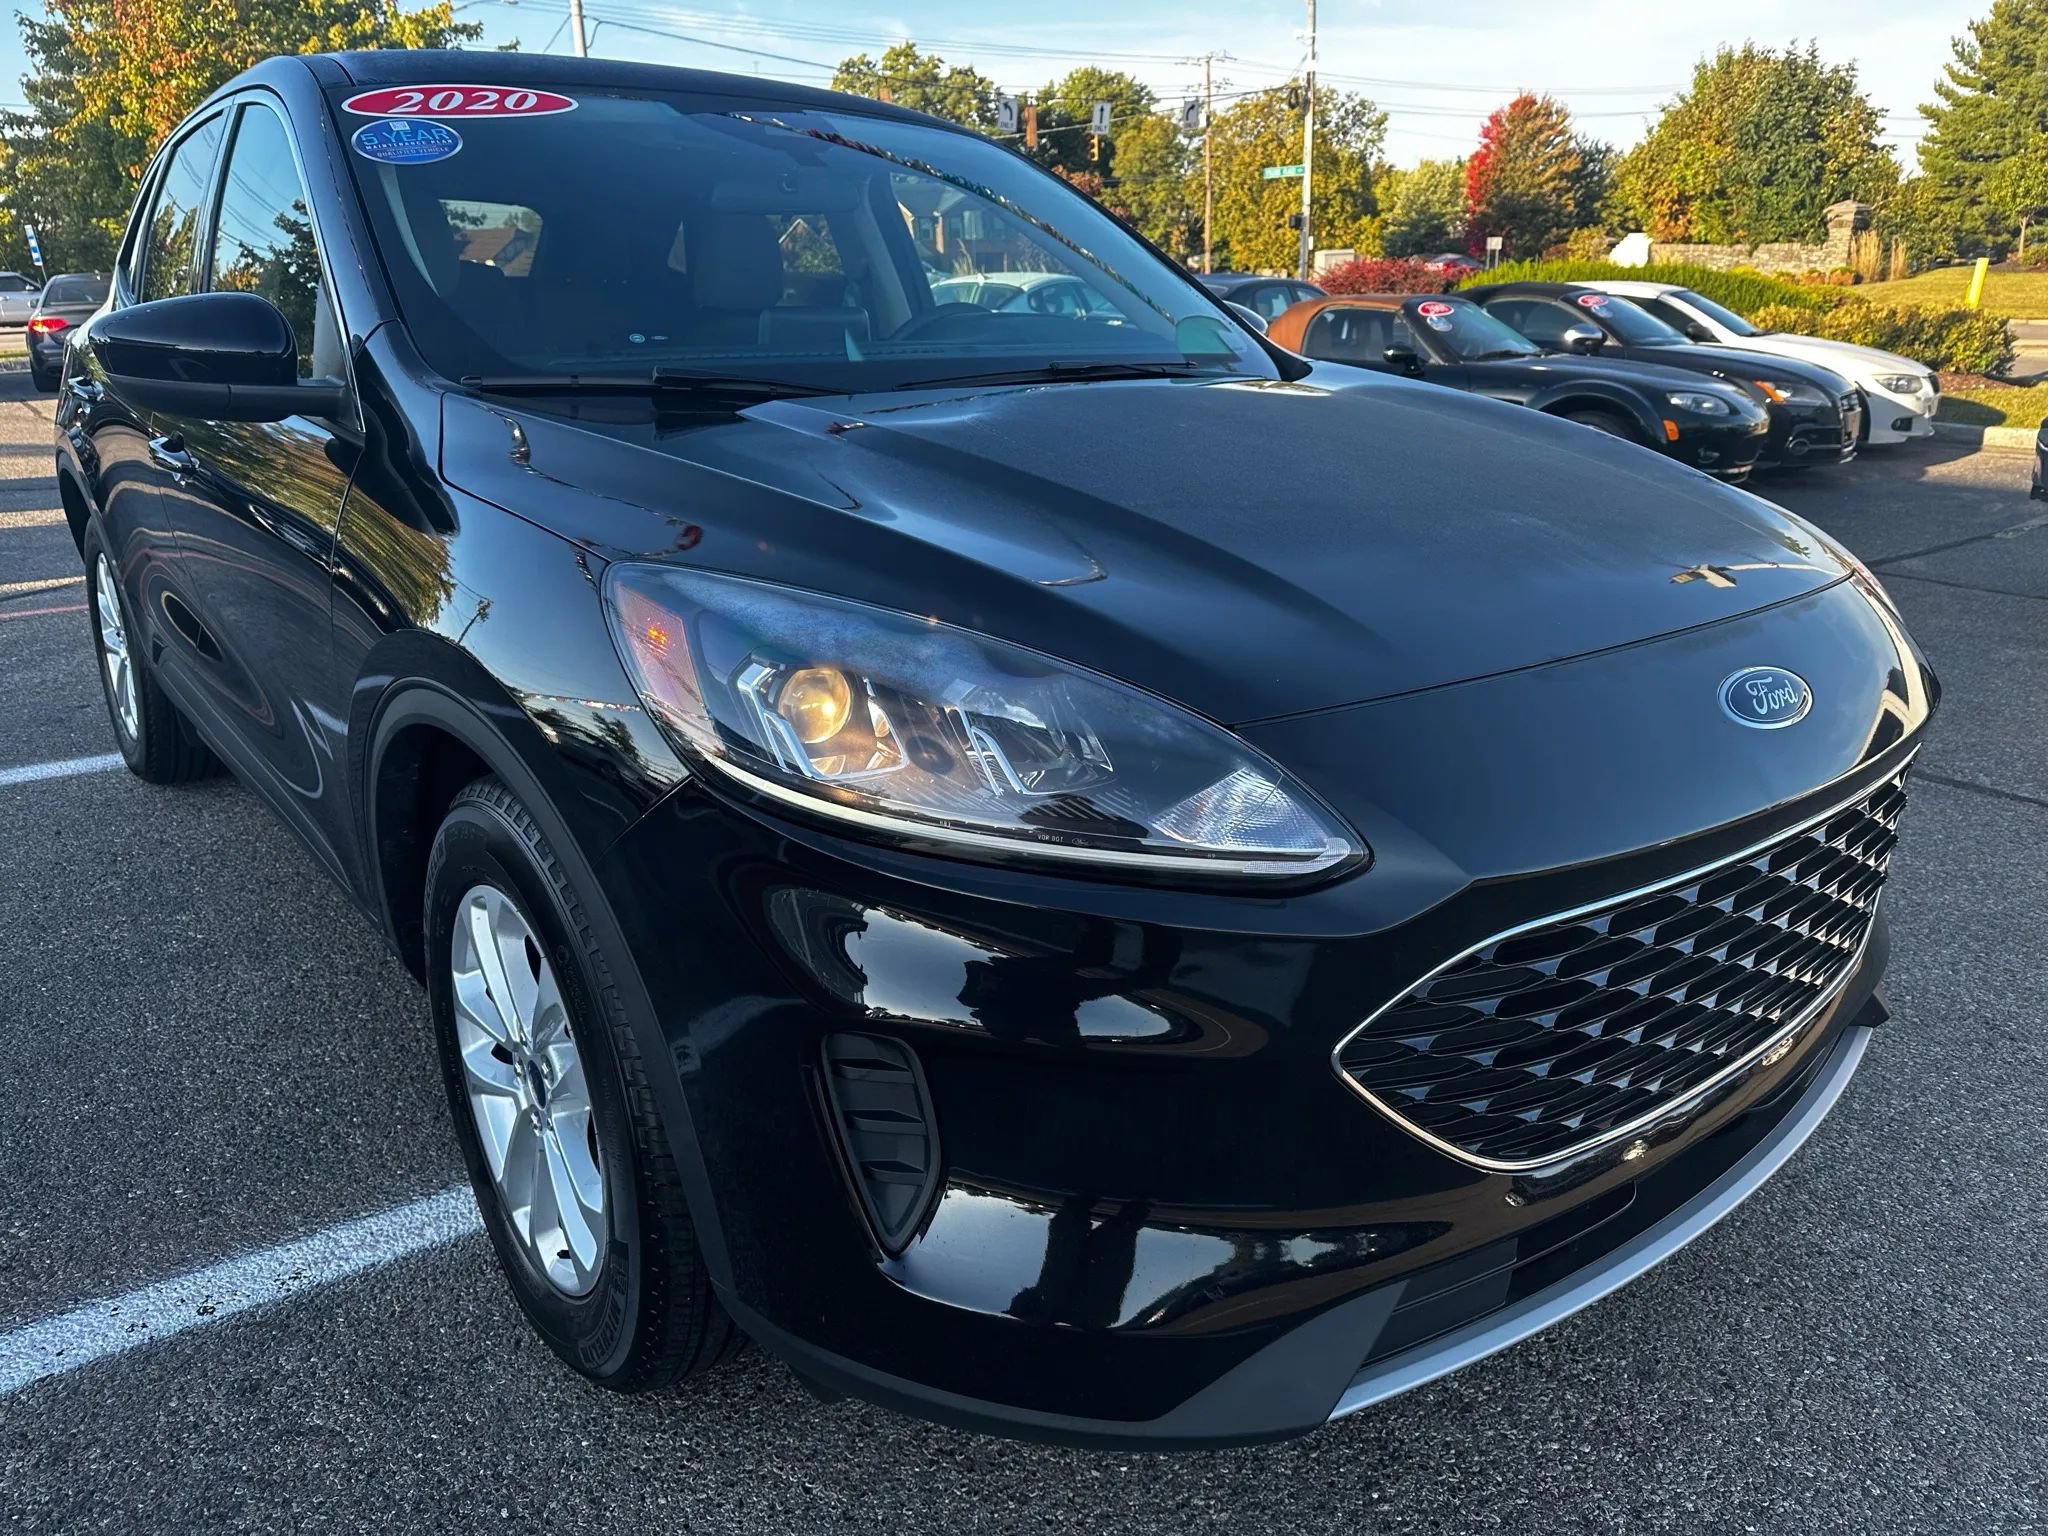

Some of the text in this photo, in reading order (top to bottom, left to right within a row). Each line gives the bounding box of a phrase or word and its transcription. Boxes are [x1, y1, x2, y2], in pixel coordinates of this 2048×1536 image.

[387, 90, 538, 113] 2020
[360, 128, 450, 146] 5 YEAR
[1745, 676, 1798, 715] Ford
